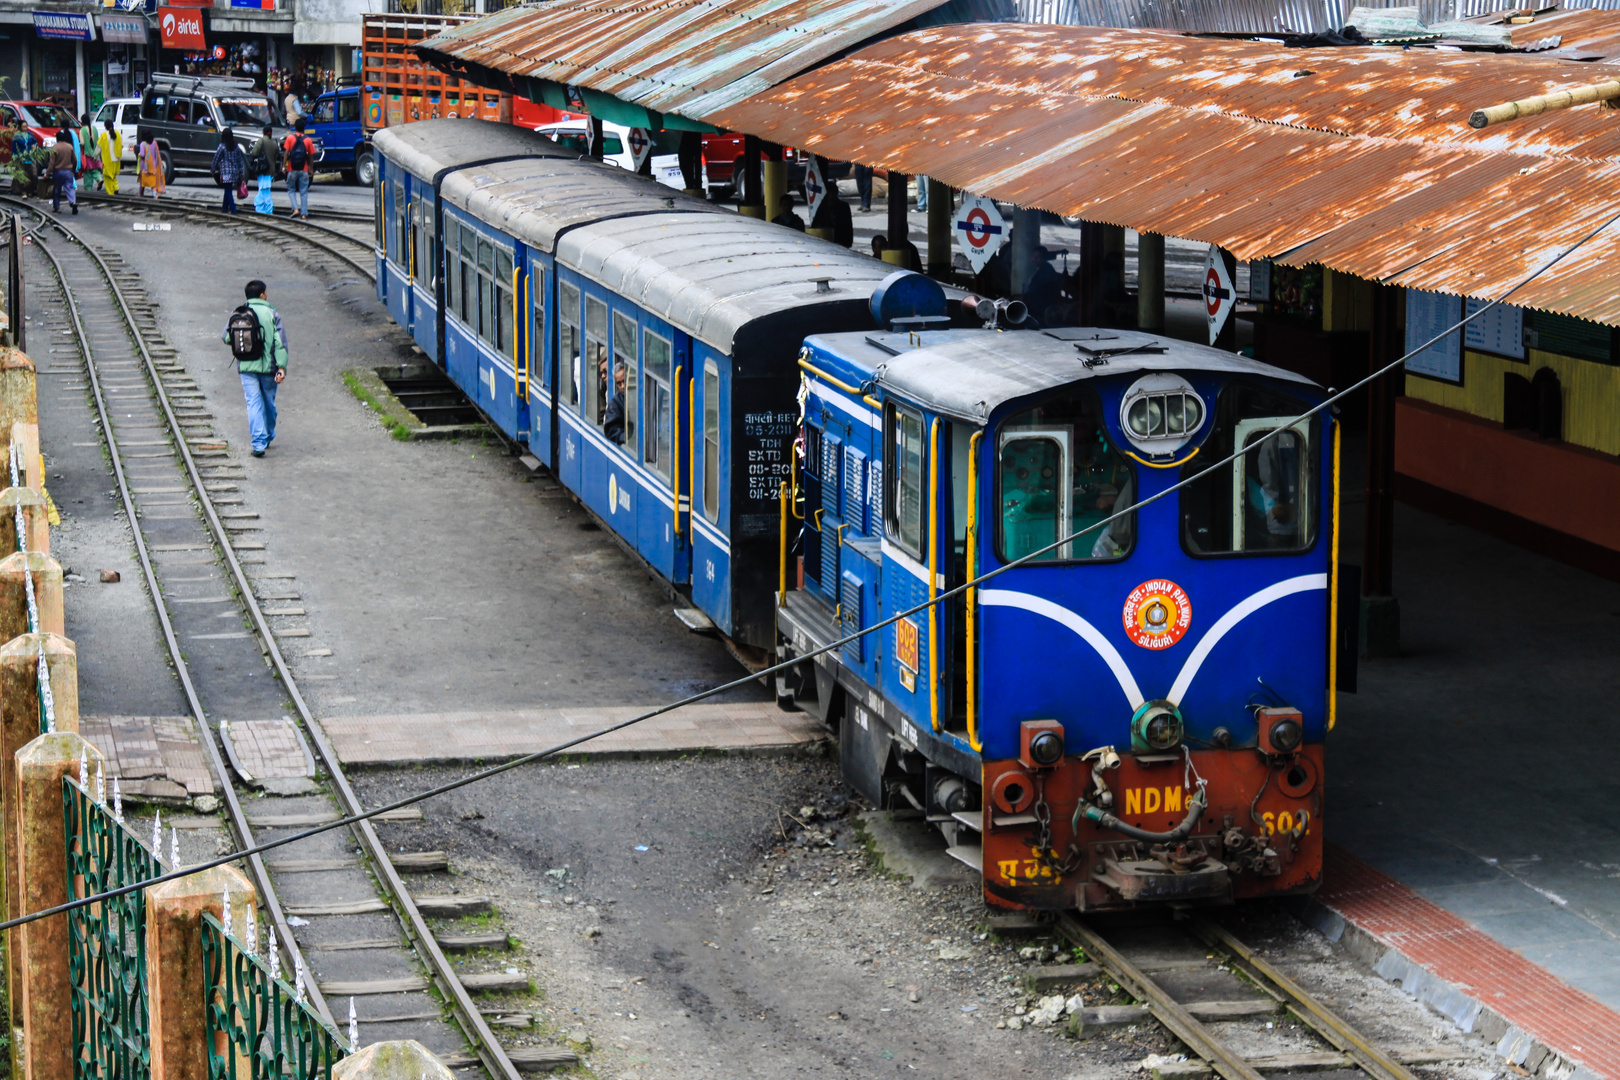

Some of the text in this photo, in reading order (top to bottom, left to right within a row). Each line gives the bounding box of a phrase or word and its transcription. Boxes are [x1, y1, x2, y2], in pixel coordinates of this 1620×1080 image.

[70, 17, 88, 30] STUDIO
[178, 18, 200, 35] airtel
[971, 247, 984, 255] GHUM
[1145, 581, 1190, 628] INDIAN RAILWAYS
[900, 618, 915, 653] 602
[1138, 635, 1173, 648] SILIGURI
